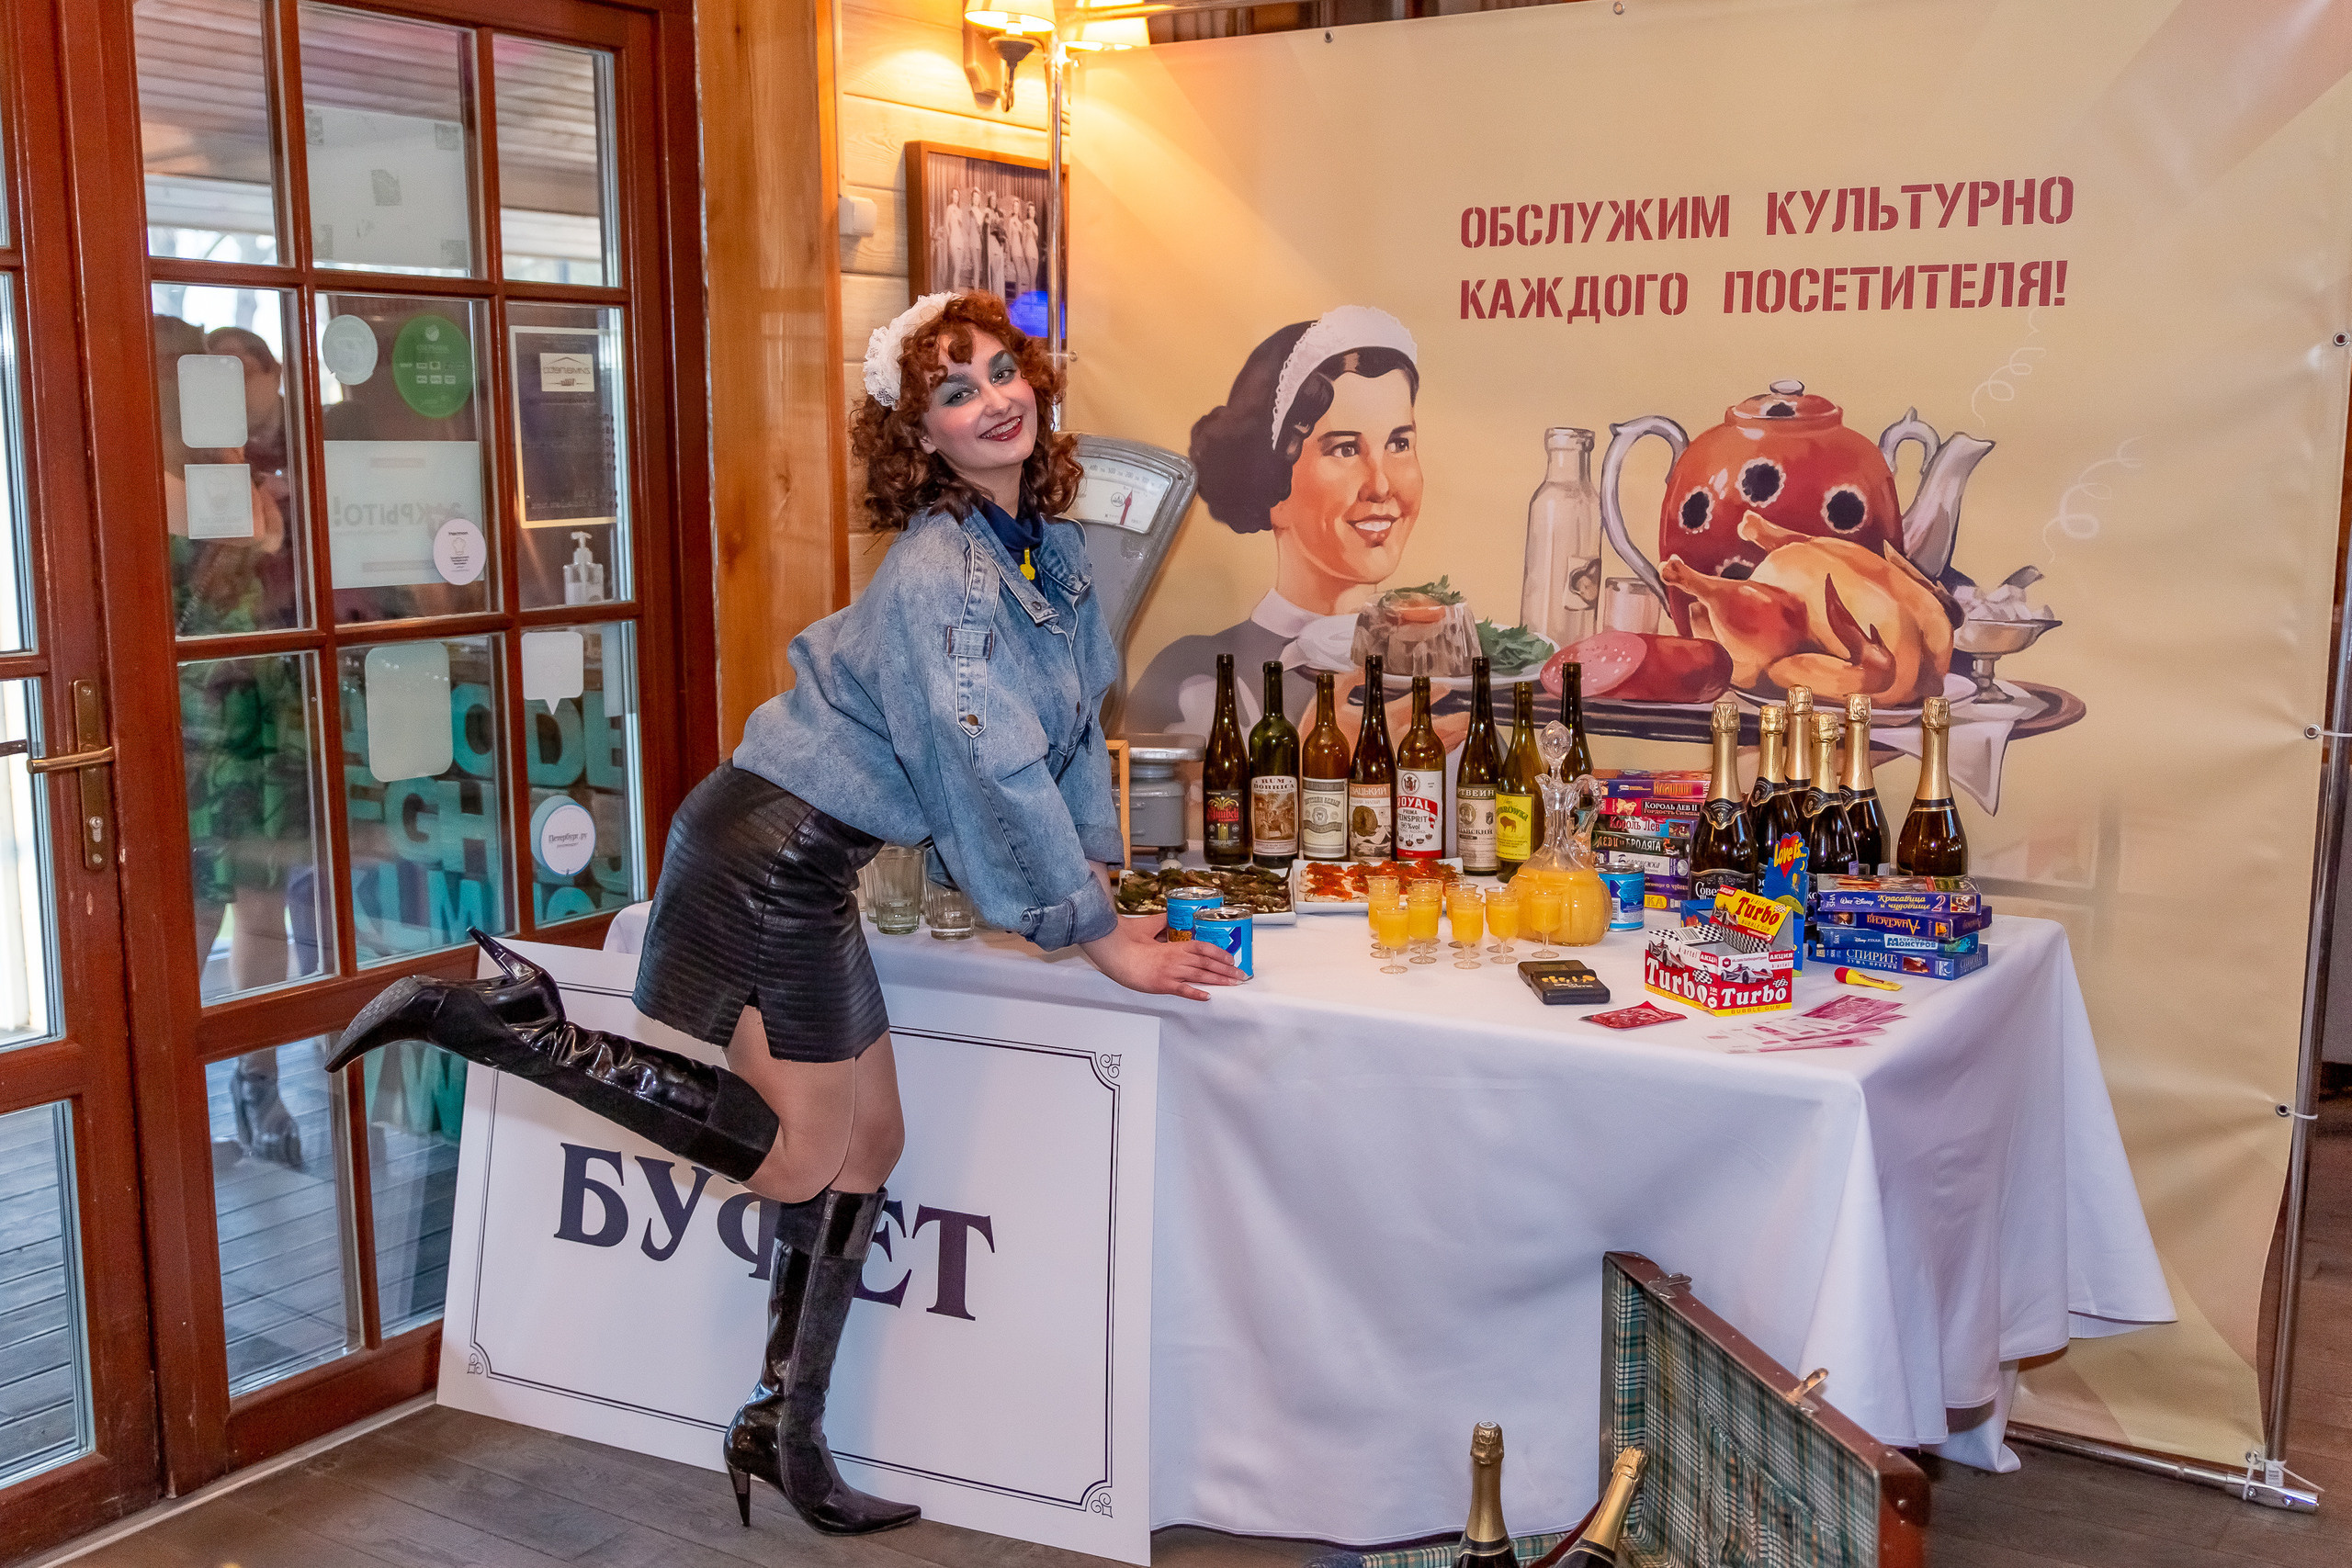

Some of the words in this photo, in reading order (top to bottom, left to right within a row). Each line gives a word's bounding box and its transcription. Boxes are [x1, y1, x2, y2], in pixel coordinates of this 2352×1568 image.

[1459, 194, 1730, 249] ОБСЛУЖИМ
[1766, 176, 2074, 236] КУЛЬТУРНО
[1459, 272, 1689, 324] КАЖДОГО
[1723, 260, 2068, 314] ПОСЕТИТЕЛЯ!
[1350, 785, 1387, 795] ЗАЦЬКИЙ
[1396, 795, 1431, 811] ROYAL
[1610, 816, 1642, 830] Король
[1644, 820, 1660, 832] Лев
[1773, 842, 1793, 867] Love
[1736, 896, 1781, 926] Turbo
[1877, 894, 1926, 903] Красавица
[1931, 895, 1946, 912] 2
[1769, 953, 1793, 961] АКЦИЯ
[1846, 949, 1898, 964] СПИРИТ:
[1645, 956, 1709, 1005] Turbo
[1721, 985, 1787, 1007] Turbo
[1731, 1007, 1761, 1015] BUBBLE
